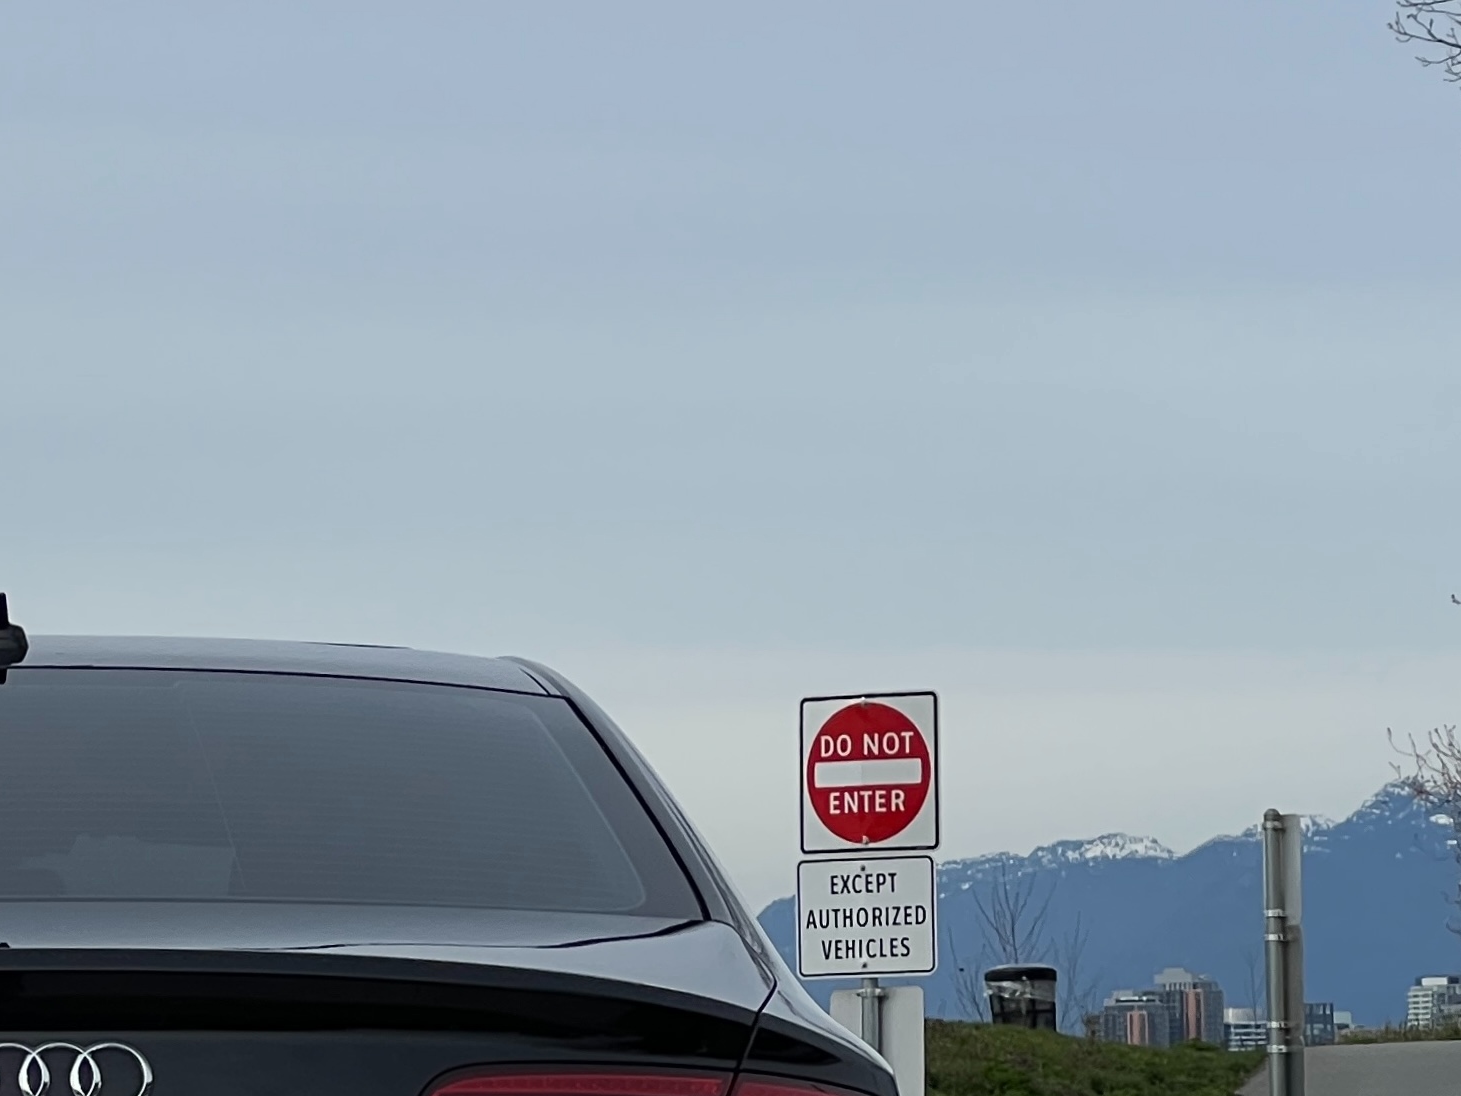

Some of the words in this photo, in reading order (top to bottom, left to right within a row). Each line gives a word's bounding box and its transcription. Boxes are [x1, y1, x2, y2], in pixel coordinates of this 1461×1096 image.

[820, 734, 852, 757] DO
[862, 732, 914, 756] NOT
[829, 790, 905, 814] ENTER
[830, 873, 897, 895] EXCEPT
[806, 905, 927, 930] AUTHORIZED
[822, 937, 911, 960] VEHICLES
